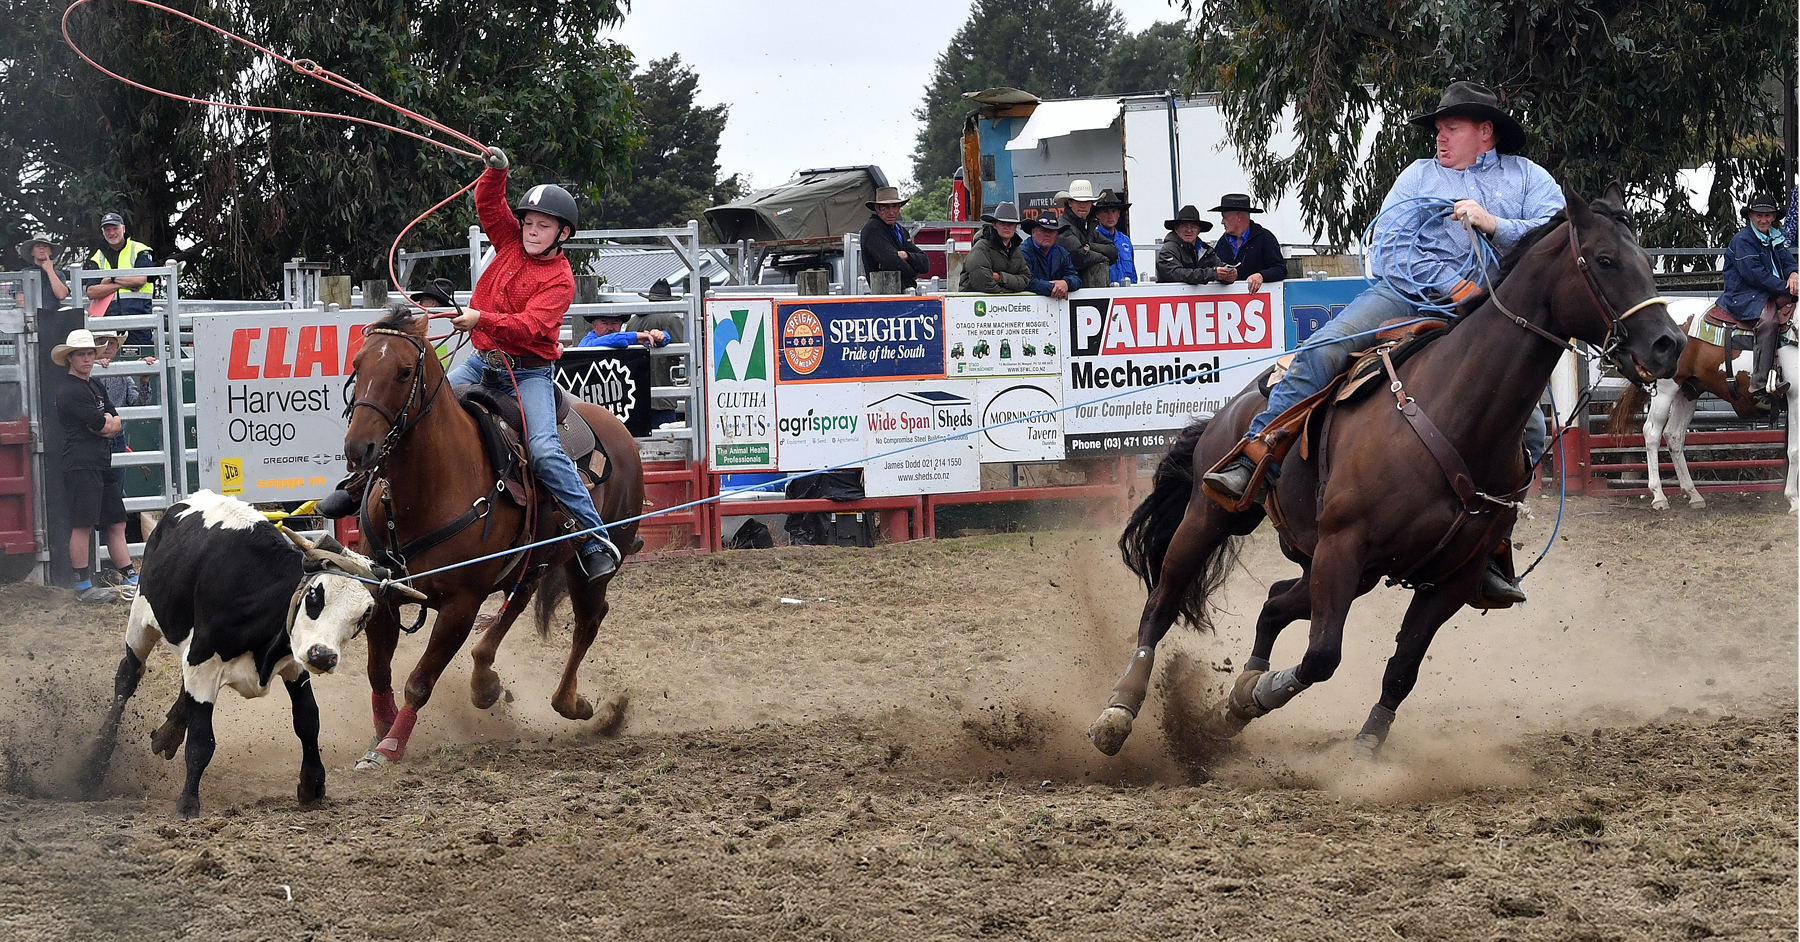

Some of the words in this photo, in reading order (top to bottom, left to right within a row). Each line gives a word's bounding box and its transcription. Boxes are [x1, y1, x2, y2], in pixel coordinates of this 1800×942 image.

[1029, 198, 1049, 207] MITRE
[1023, 207, 1065, 220] TRDE
[988, 304, 1007, 313] JOHN
[1008, 303, 1031, 312] DEERE
[786, 313, 820, 335] SPEIGHT'S
[1025, 320, 1049, 328] MOSGIEL
[1076, 299, 1266, 350] PALMERS
[789, 349, 799, 365] GOLD
[812, 348, 820, 360] ALE
[841, 347, 868, 361] Pride
[869, 346, 881, 363] of
[880, 345, 896, 359] the
[897, 344, 925, 359] South
[1071, 356, 1220, 389] Mechanical
[228, 384, 330, 413] Harvest
[579, 380, 623, 405] GRID
[717, 391, 766, 408] CLUTHA
[1074, 404, 1099, 418] Your
[1101, 401, 1153, 419] Complete
[1155, 398, 1220, 417] Engineering
[779, 409, 858, 436] agrispray
[866, 412, 897, 431] Wide
[900, 411, 930, 433] Span
[938, 408, 973, 428] Sheds
[990, 410, 1057, 424] MORNINGTON
[228, 418, 296, 446] Otago
[1028, 426, 1057, 440] Tavern
[883, 436, 913, 445] Compromise
[914, 435, 927, 443] Steel
[1072, 438, 1101, 450] Phone
[1103, 438, 1121, 450] (03)
[1123, 437, 1140, 448] 471
[1142, 435, 1165, 446] 0516
[716, 447, 728, 455] The
[730, 446, 748, 454] Animal
[749, 446, 768, 454] Health
[263, 455, 310, 464] GREGOIRE
[723, 455, 762, 464] Professionals
[884, 461, 904, 470] James
[905, 459, 920, 469] Dodd
[922, 459, 933, 467] 021
[935, 458, 946, 467] 214
[947, 458, 961, 467] 1550
[224, 464, 239, 480] JCB
[897, 472, 950, 481] www.sheds.co.nz
[256, 475, 304, 490] seppi
[309, 476, 325, 486] m
